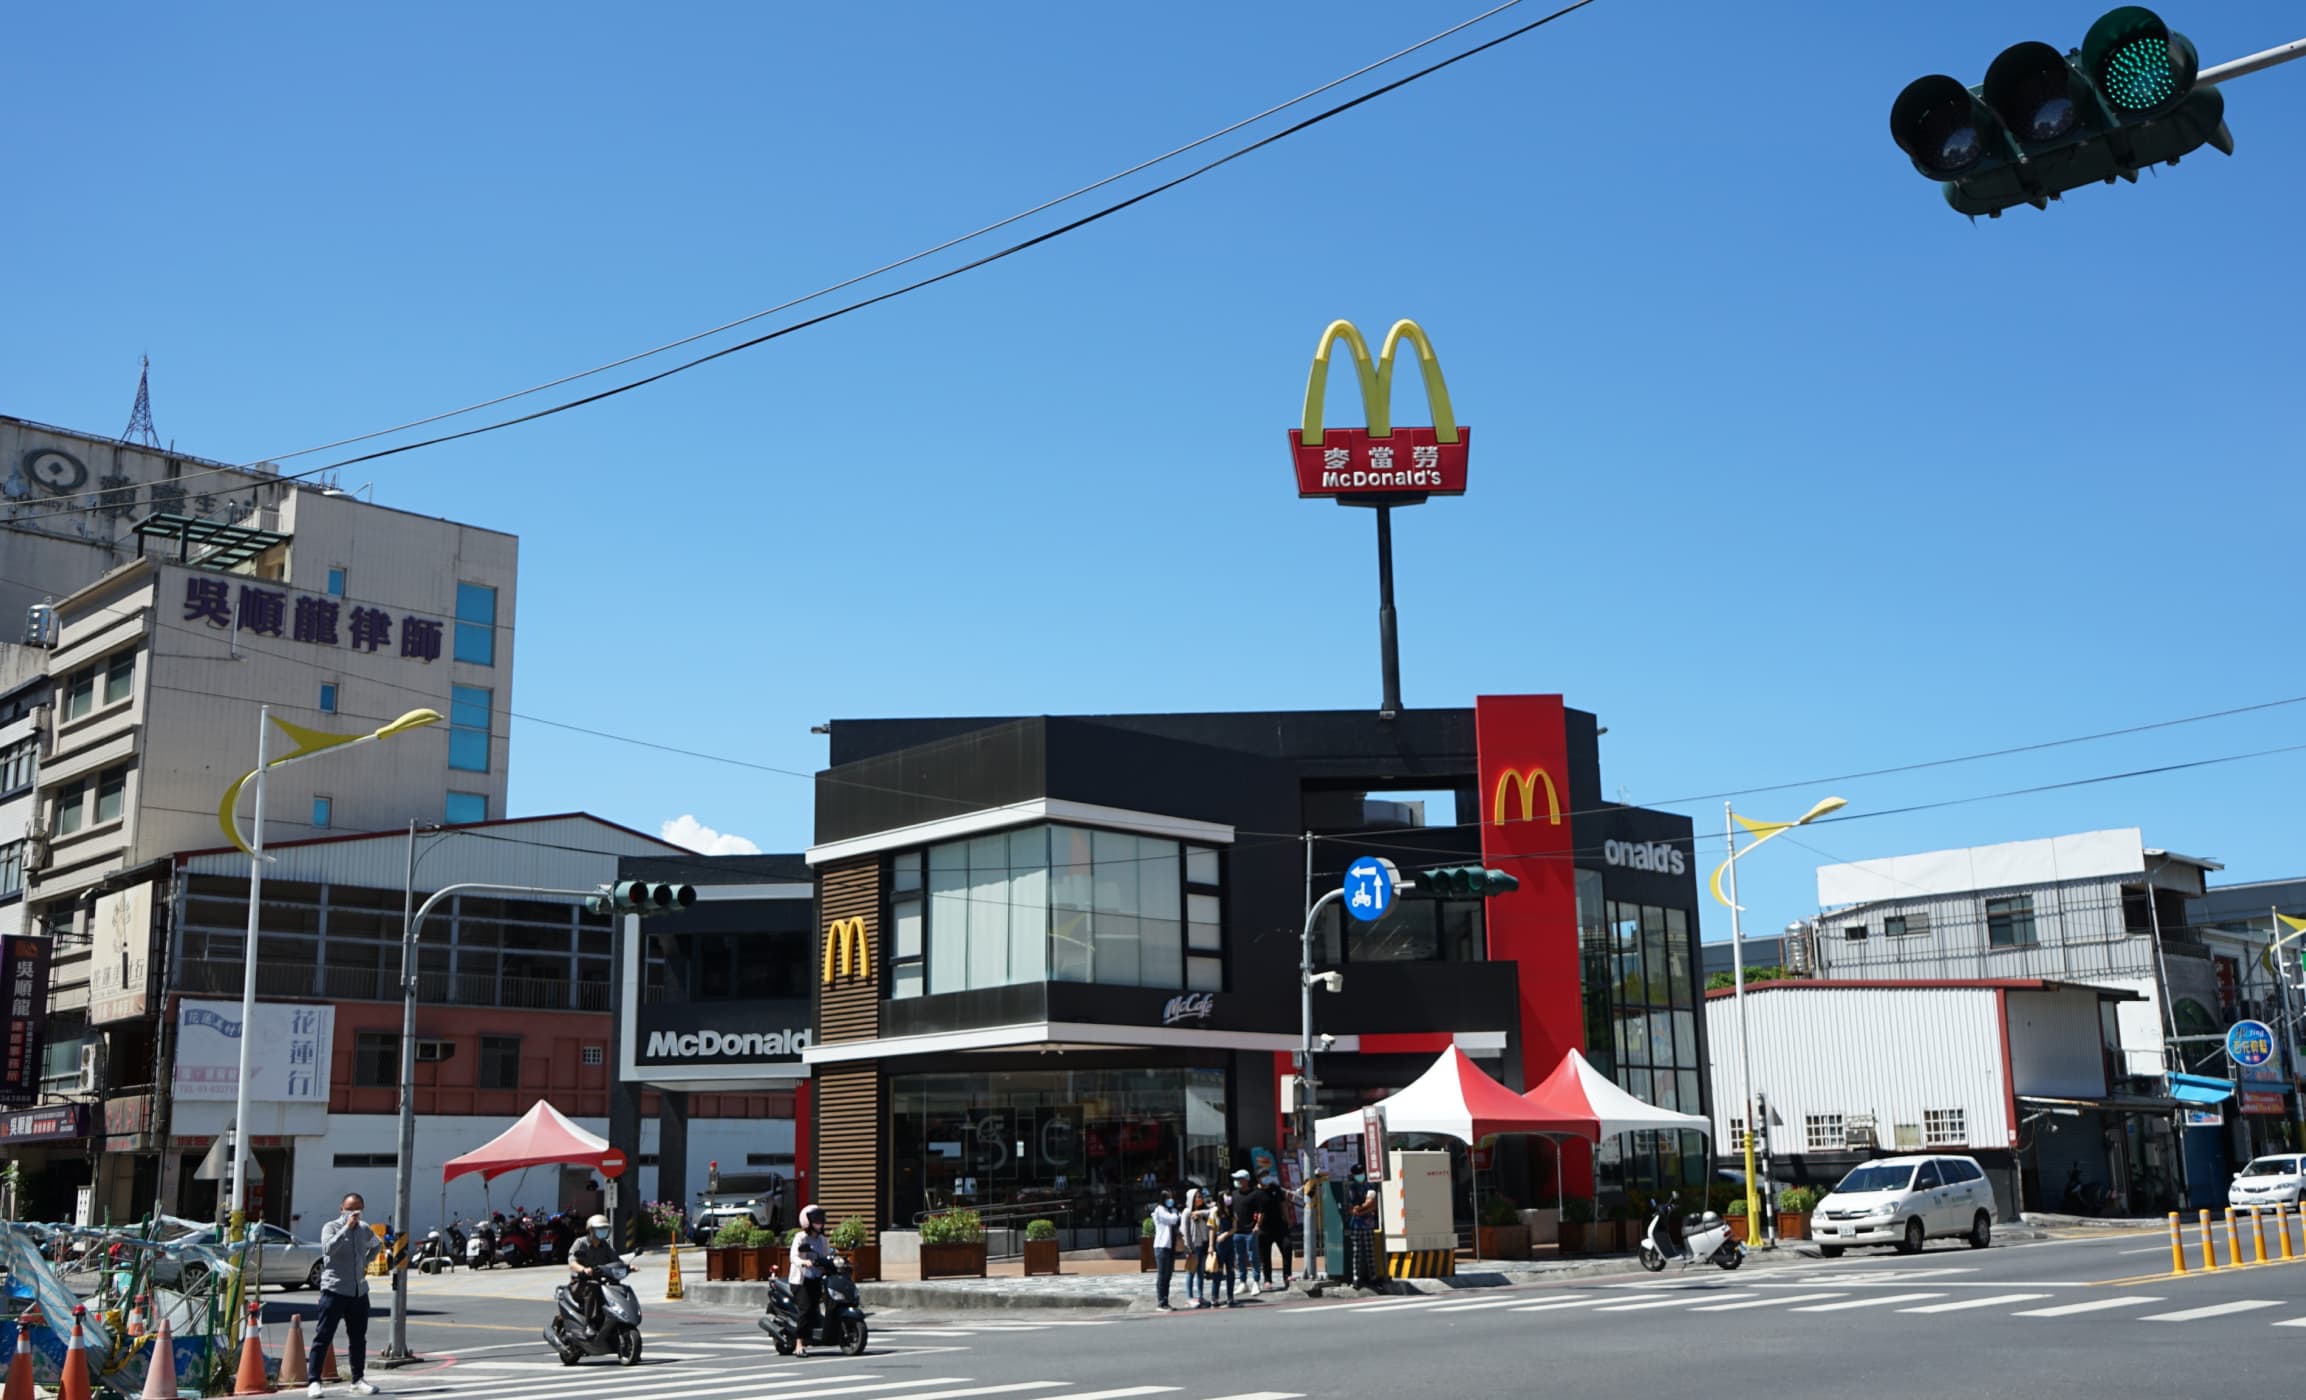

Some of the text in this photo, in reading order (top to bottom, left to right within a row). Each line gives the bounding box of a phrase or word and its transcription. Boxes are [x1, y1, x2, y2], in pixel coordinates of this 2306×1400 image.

[1324, 446, 1438, 470] 麥當勞
[1322, 470, 1442, 488] McDonald's
[184, 577, 443, 663] 吳順龍律師
[1604, 839, 1685, 875] onald's
[12, 960, 34, 1017] 吳順龍
[288, 1009, 315, 1096] 花蓮行
[647, 1028, 812, 1057] McDonald
